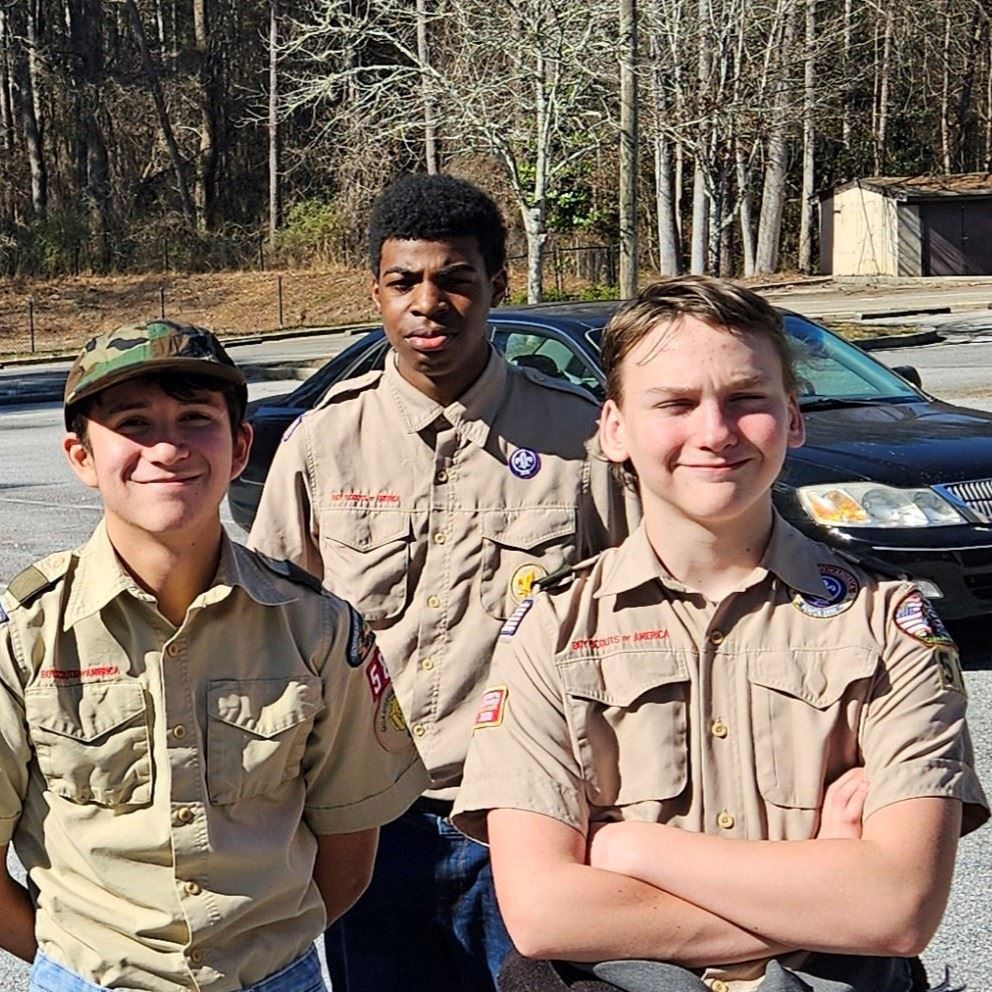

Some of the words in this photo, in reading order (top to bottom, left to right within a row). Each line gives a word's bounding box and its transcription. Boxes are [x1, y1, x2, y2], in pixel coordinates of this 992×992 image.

[571, 640, 588, 650] BOY
[589, 636, 620, 649] SCOUTS
[634, 629, 669, 642] AMERICA
